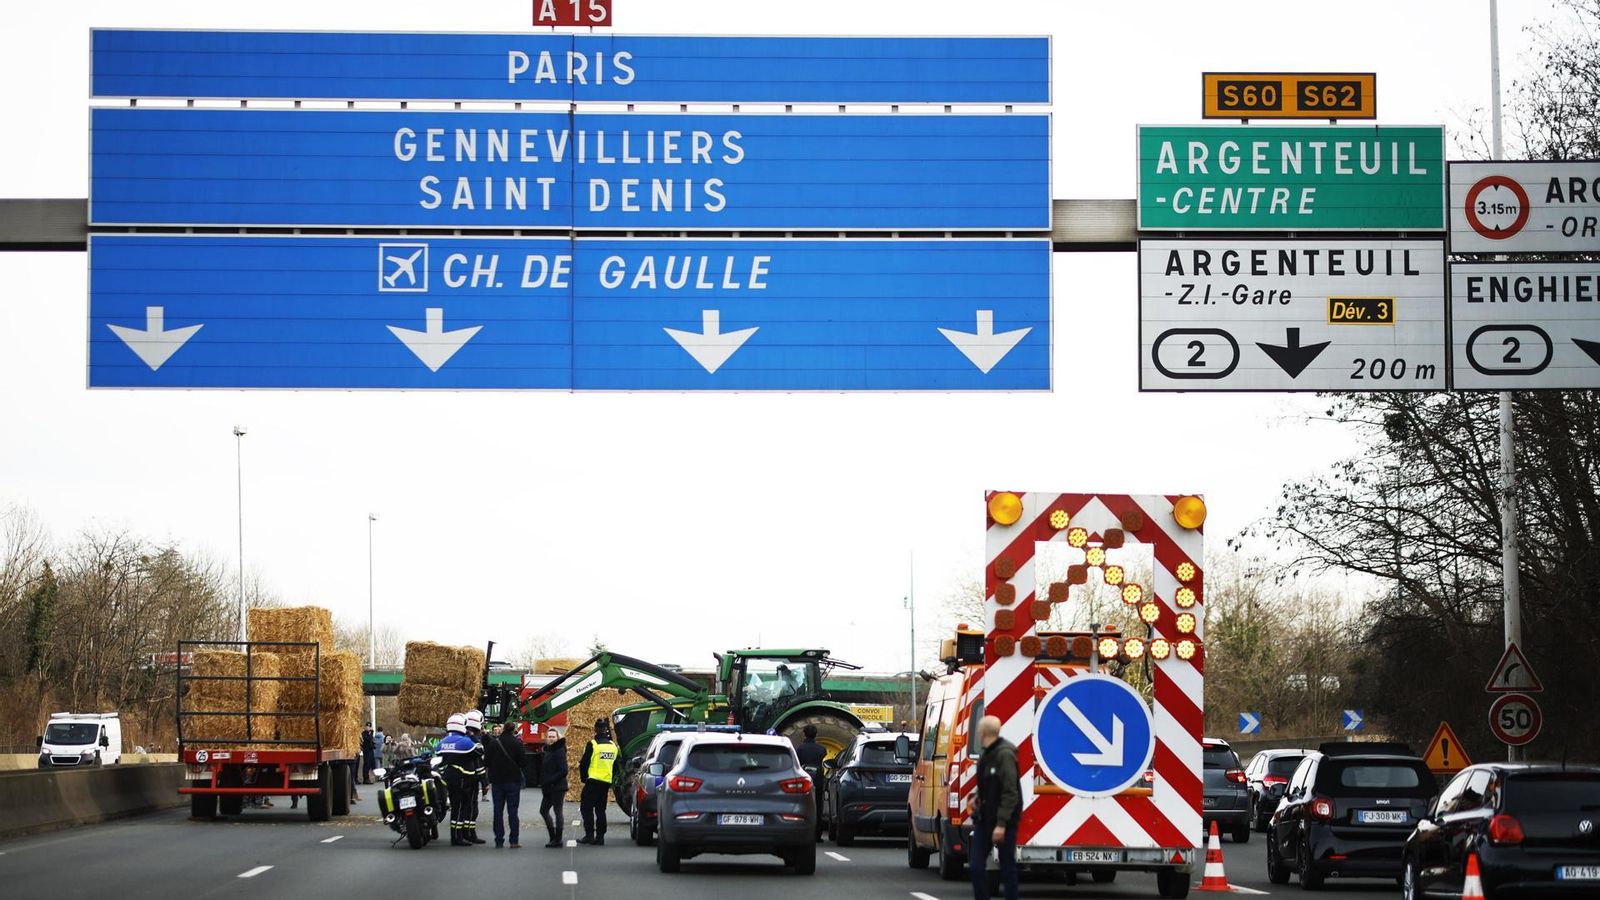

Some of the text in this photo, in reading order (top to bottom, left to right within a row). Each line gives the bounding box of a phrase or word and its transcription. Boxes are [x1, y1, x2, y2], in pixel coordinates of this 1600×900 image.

[539, 0, 606, 22] A 15
[509, 51, 634, 85] PARIS
[1224, 85, 1355, 106] S60 S62
[394, 128, 744, 164] GENNEVILLIERS
[1157, 141, 1426, 174] ARGENTEUIL
[420, 176, 726, 212] SAINT DENIS
[1157, 187, 1316, 214] -CENTRE
[1477, 201, 1517, 215] 3.15m
[444, 254, 770, 289] CH. DE GAULLE
[1165, 249, 1419, 276] ARGENTEUIL
[1467, 276, 1600, 303] ENGHIE
[1332, 302, 1388, 320] Dév. 3
[1188, 341, 1205, 366] 2
[1502, 337, 1521, 363] 2
[1351, 359, 1435, 379] 200 m
[1501, 709, 1531, 730] 50
[198, 751, 206, 761] 25
